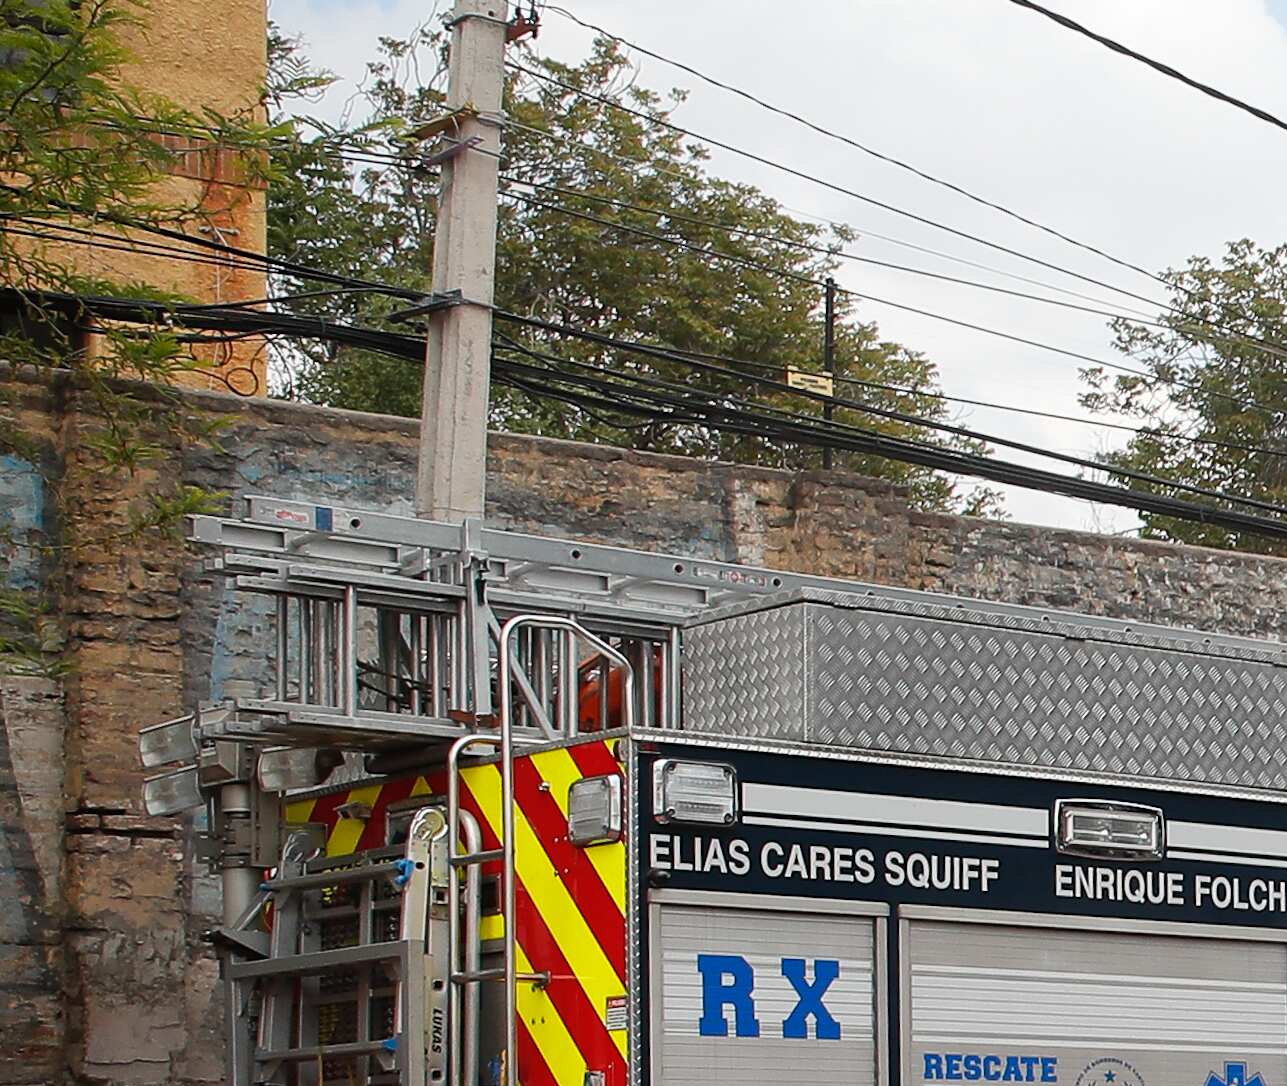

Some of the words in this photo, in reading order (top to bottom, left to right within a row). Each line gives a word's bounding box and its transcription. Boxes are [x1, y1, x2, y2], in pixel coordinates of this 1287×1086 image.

[649, 833, 750, 875] ELIAS
[761, 842, 876, 884] CARES
[885, 851, 999, 892] SQUIFF
[1055, 864, 1184, 905] ENRIQUE
[1195, 876, 1286, 912] FOLCH
[431, 1008, 443, 1054] LUKAS
[923, 1053, 1057, 1082] RESCATE
